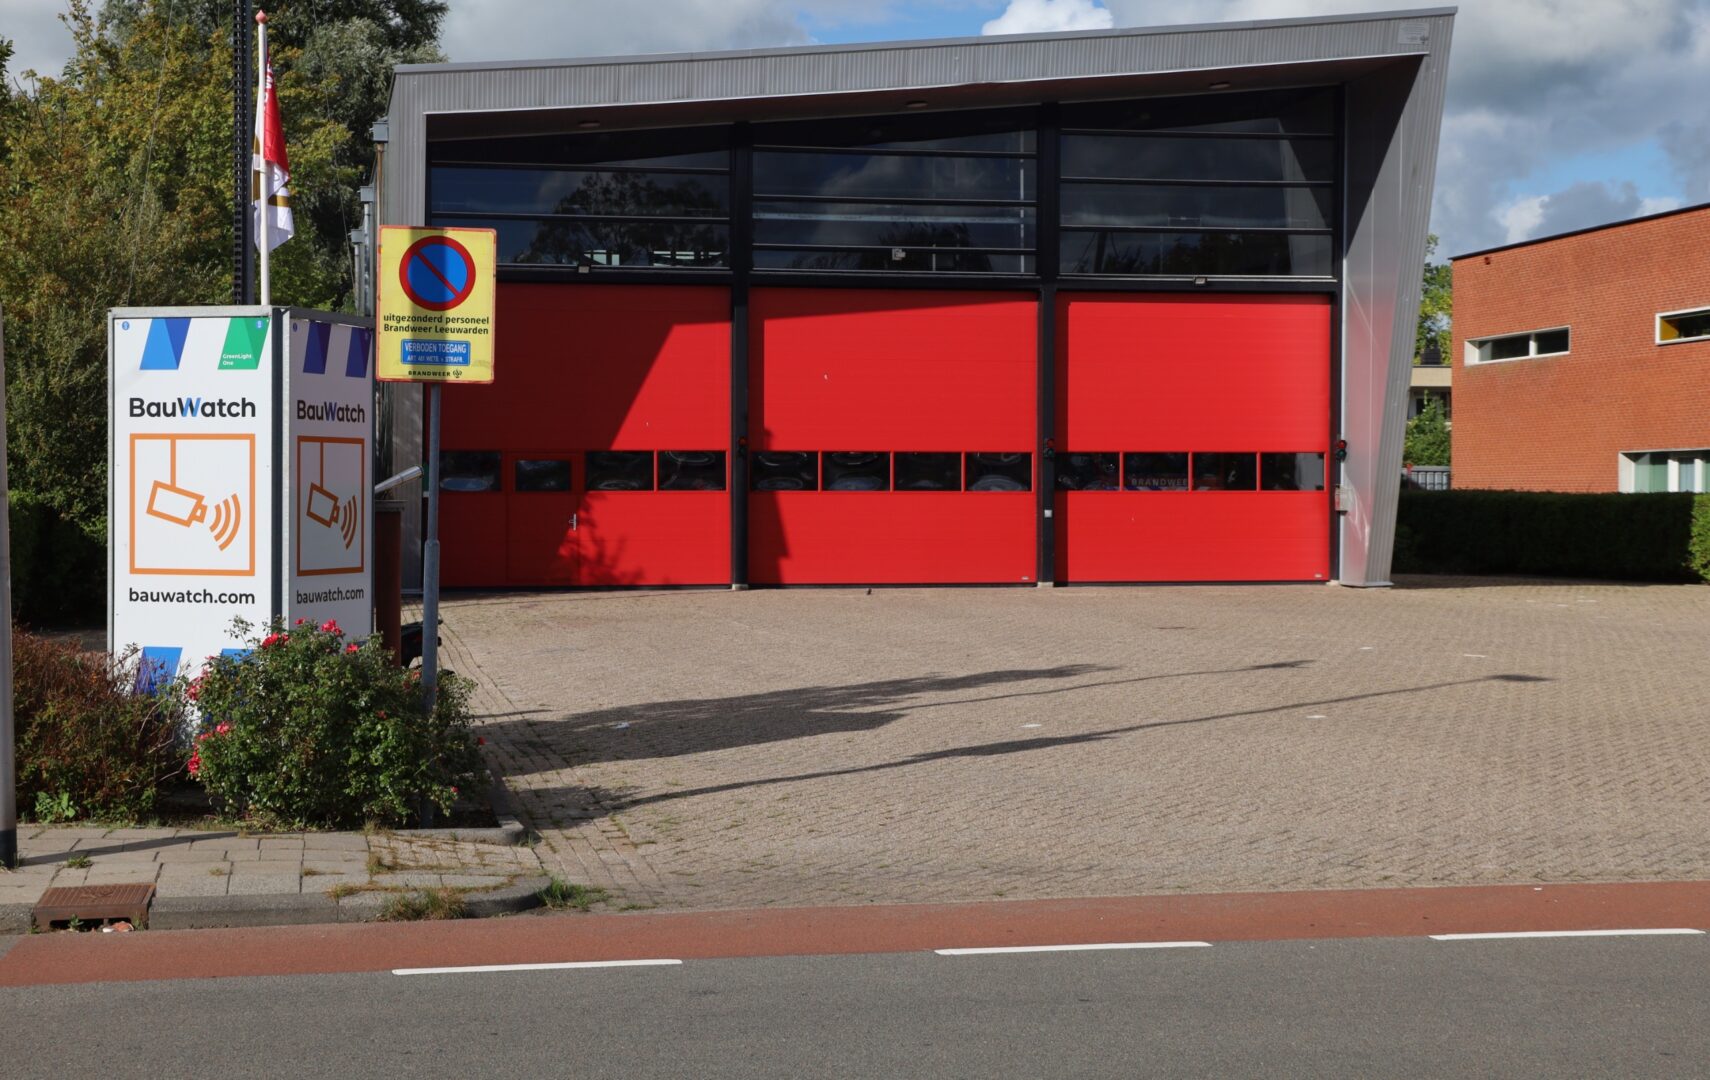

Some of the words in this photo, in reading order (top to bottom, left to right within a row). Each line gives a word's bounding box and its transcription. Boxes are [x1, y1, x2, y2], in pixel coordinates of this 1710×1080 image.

[383, 313, 443, 324] uitgezonderd
[445, 315, 490, 325] personeel
[383, 323, 432, 334] Brandweer
[434, 325, 489, 335] Leeuwarden
[404, 342, 437, 353] VERBODEN
[438, 344, 467, 354] TOEGANG
[129, 397, 256, 418] BauWatch
[297, 399, 366, 423] BauWatch
[129, 588, 255, 604] bauwatch.com
[296, 588, 364, 604] bauwatch.com
